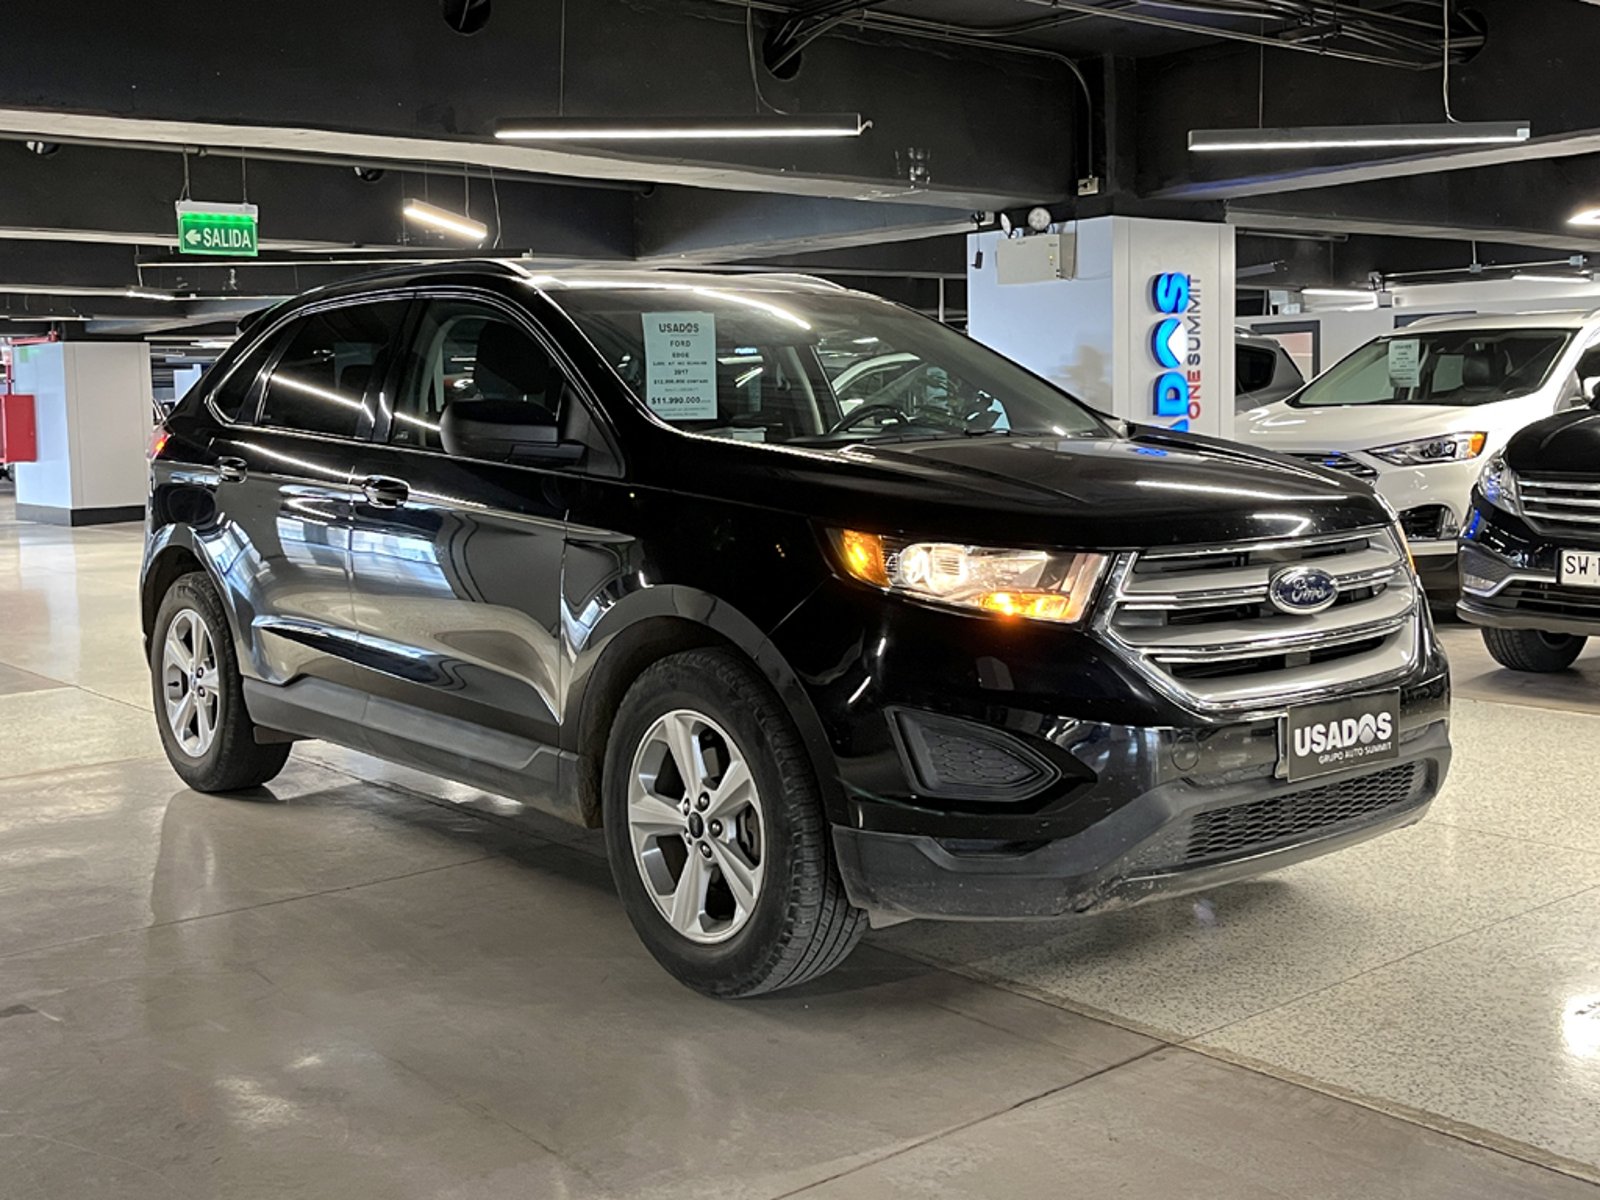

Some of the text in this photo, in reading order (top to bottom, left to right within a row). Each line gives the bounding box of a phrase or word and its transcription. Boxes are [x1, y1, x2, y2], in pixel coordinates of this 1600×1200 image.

[202, 227, 252, 248] SALIDA
[658, 323, 699, 333] USADOS
[1187, 274, 1201, 420] ONE SUMMIT
[651, 396, 701, 405] $11.990.000
[1291, 576, 1328, 602] Ford
[1294, 712, 1392, 757] USADOS
[1318, 742, 1392, 764] GRUPO AUTO SUMMIT
